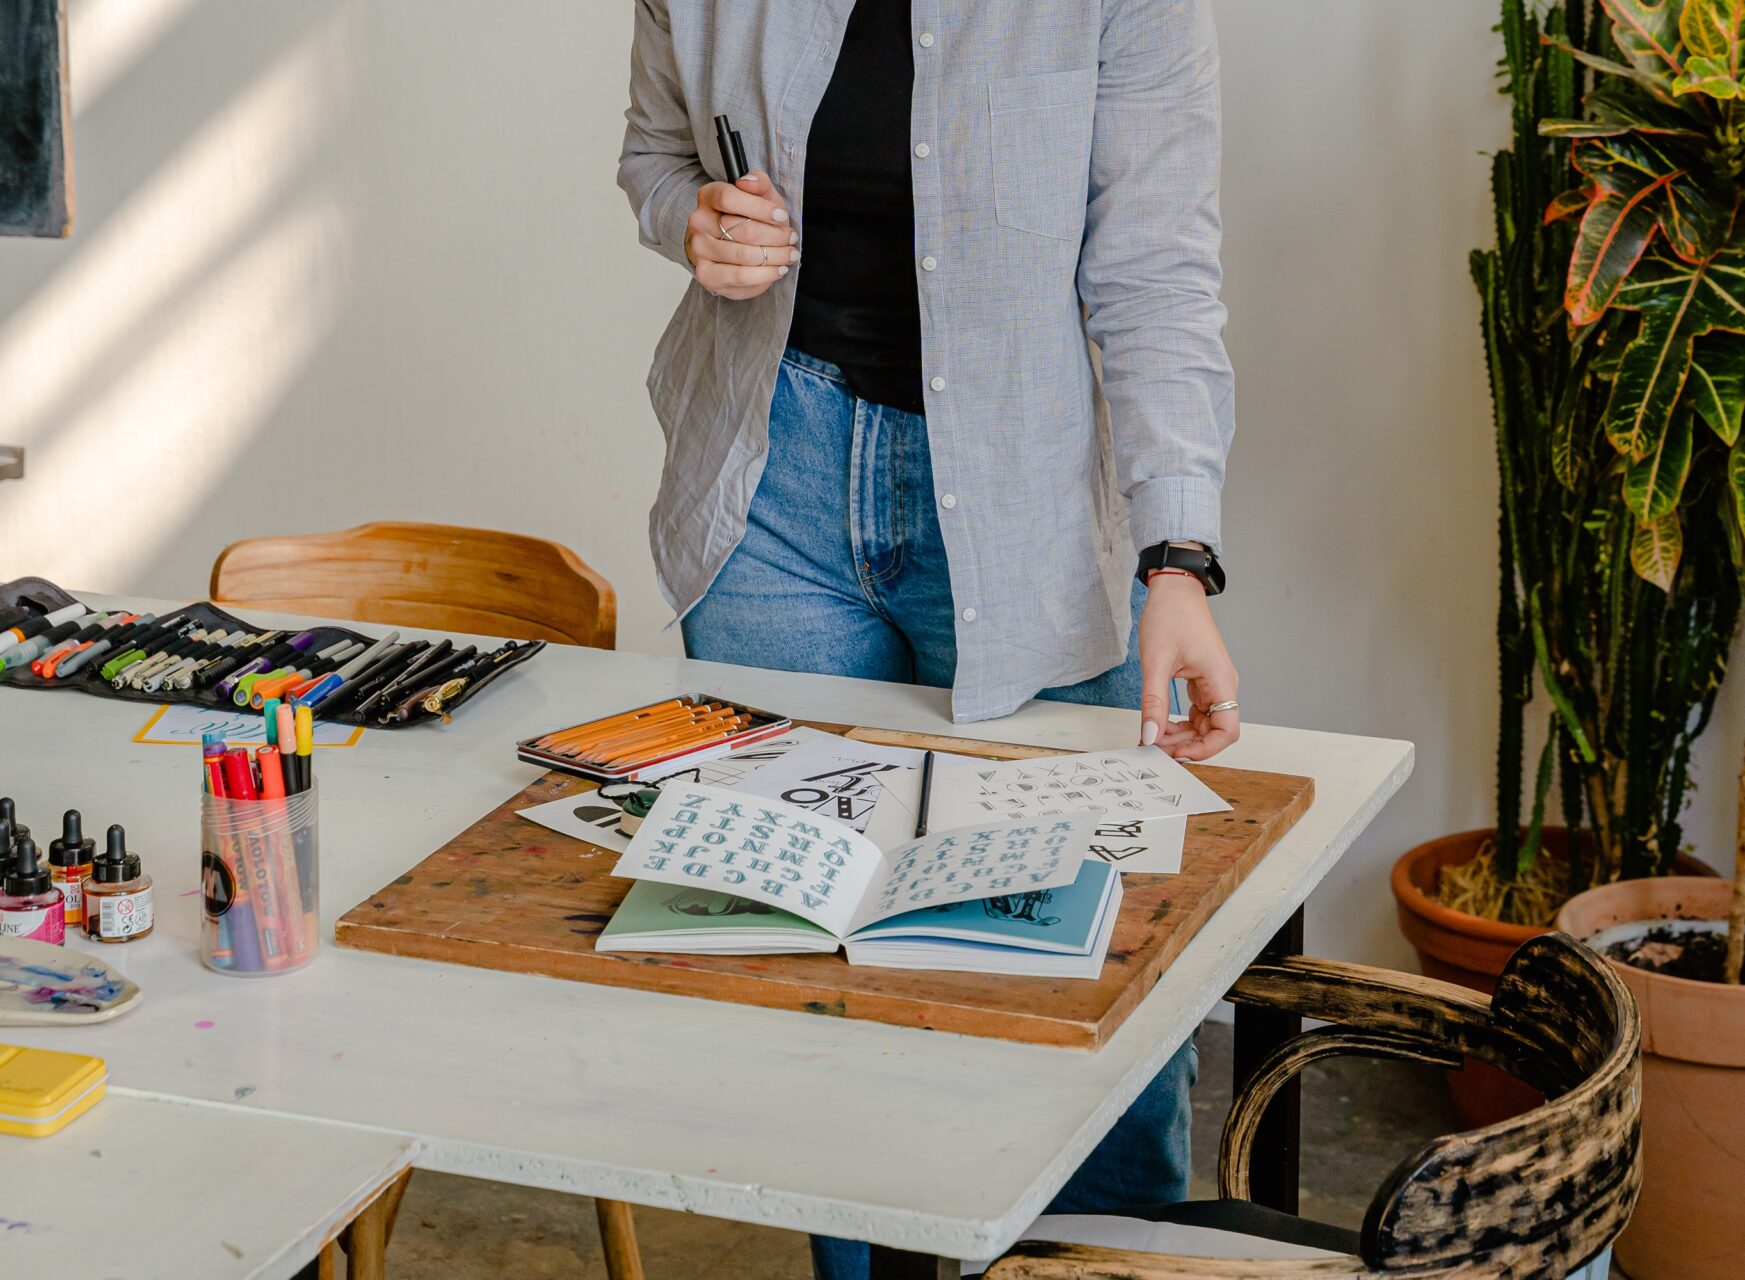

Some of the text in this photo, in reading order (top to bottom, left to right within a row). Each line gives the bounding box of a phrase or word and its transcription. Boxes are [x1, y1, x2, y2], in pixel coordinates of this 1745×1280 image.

[662, 825, 840, 882] L M N O P
[670, 810, 846, 866] Q R S T U
[679, 794, 853, 856] V W X Y Z
[644, 856, 828, 910] A B C D E
[650, 840, 835, 898] F G H I J K
